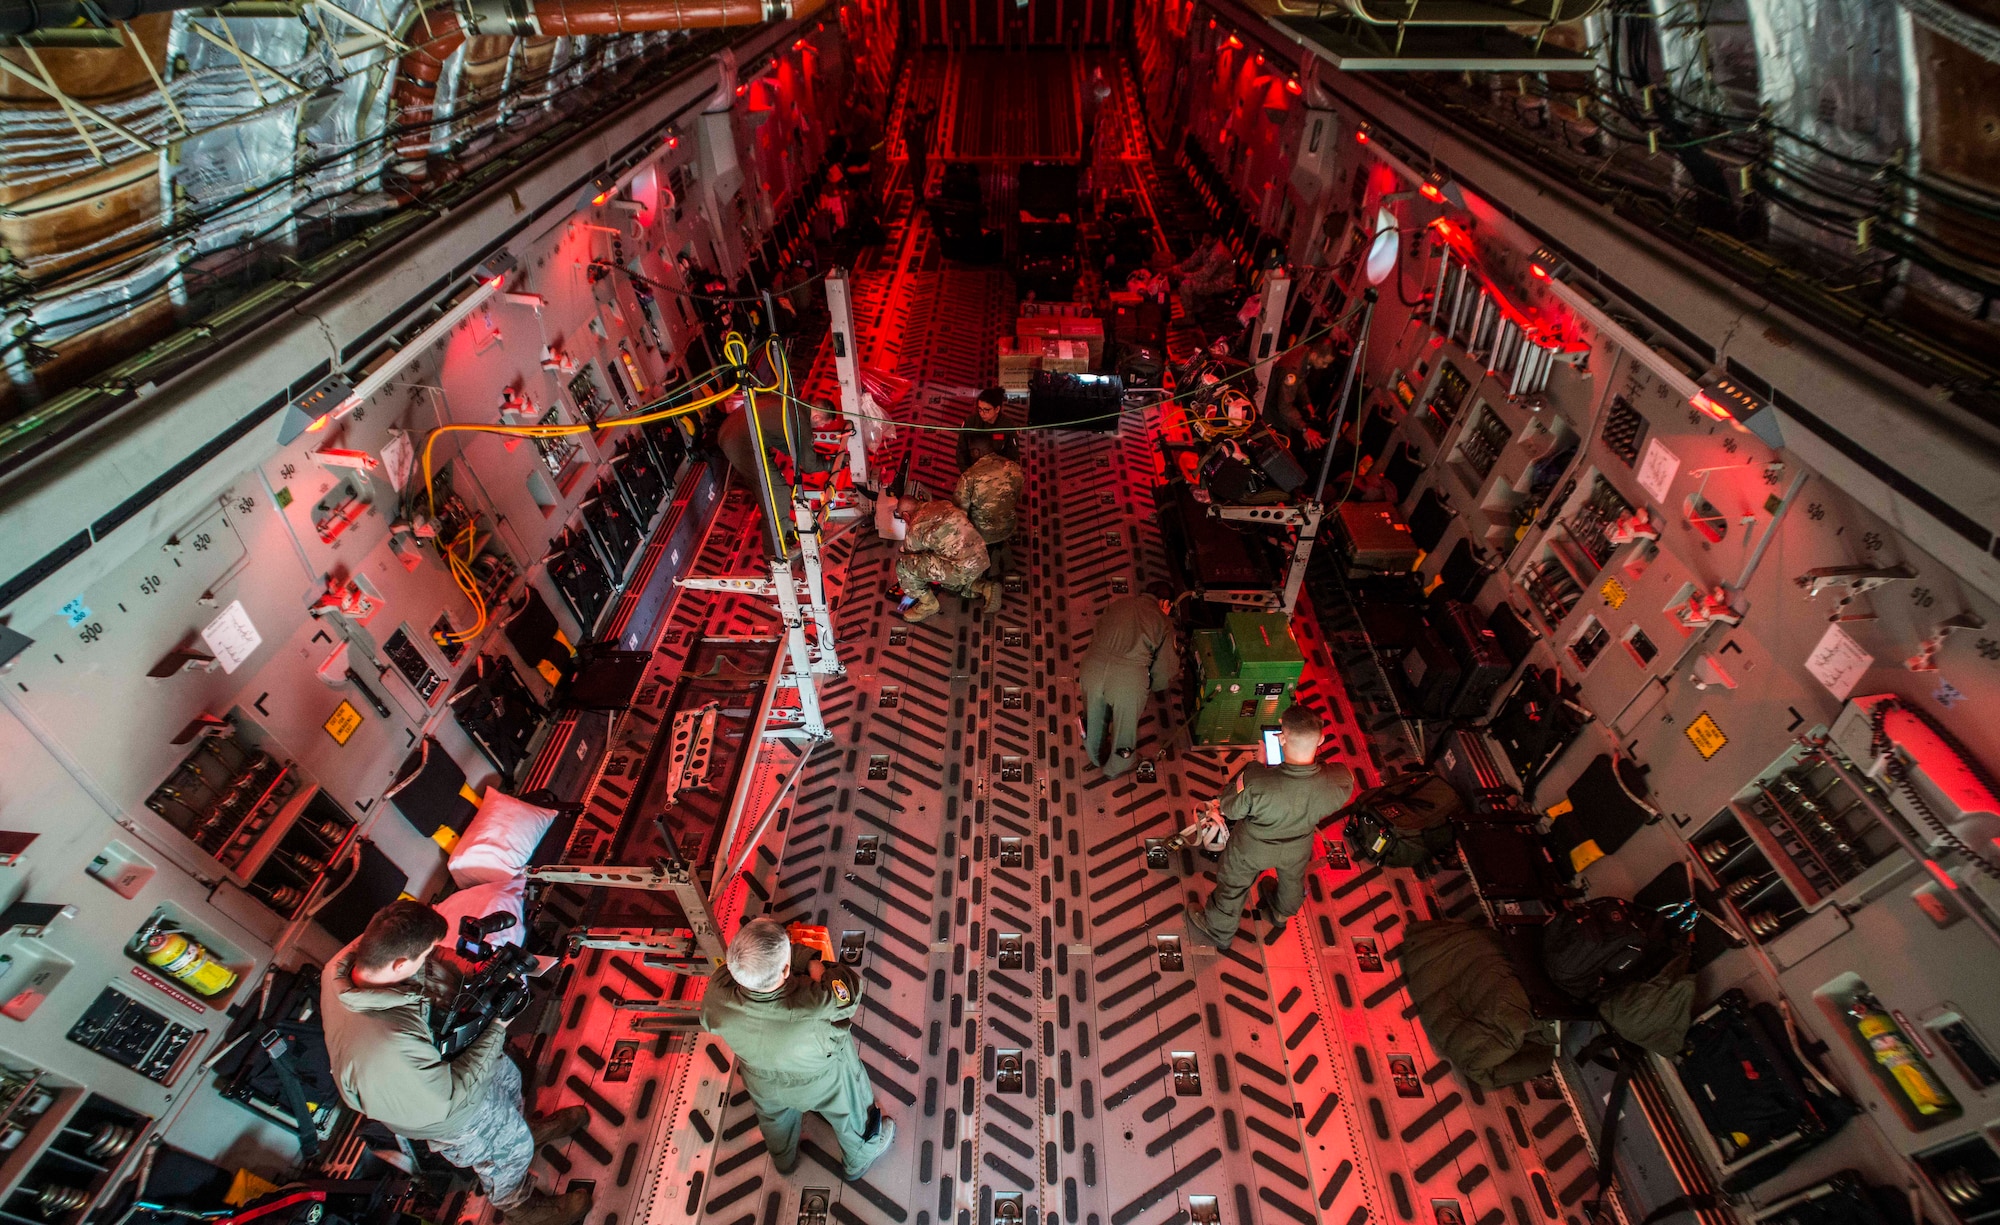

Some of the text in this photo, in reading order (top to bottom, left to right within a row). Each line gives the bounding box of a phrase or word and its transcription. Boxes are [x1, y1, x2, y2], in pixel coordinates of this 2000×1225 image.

[280, 464, 296, 480] 540
[1762, 469, 1779, 486] 540
[239, 496, 255, 514] 530
[1808, 503, 1825, 521] 530
[193, 533, 211, 552] 520
[1862, 531, 1884, 552] 520
[140, 574, 161, 595] 510
[1911, 586, 1934, 608] 510
[79, 622, 103, 644] 500
